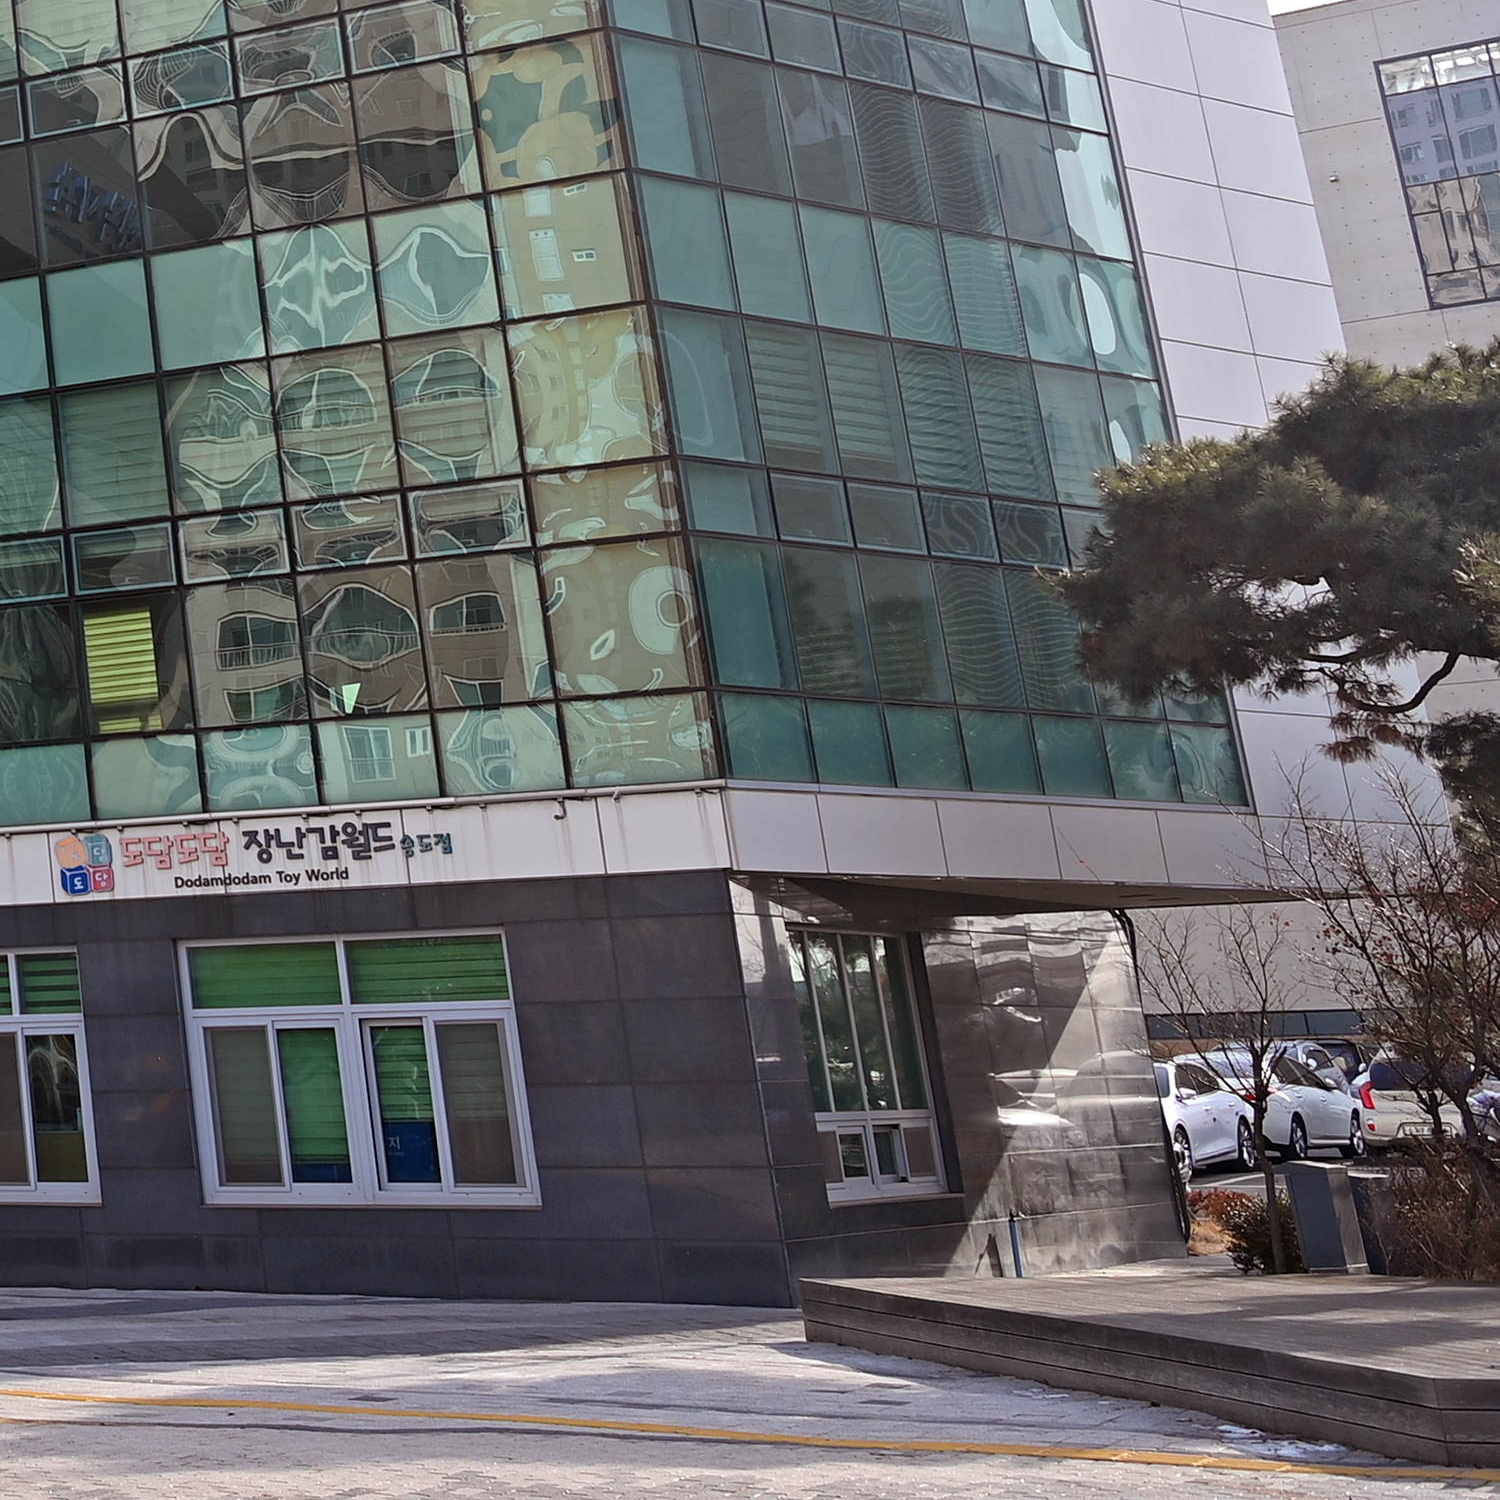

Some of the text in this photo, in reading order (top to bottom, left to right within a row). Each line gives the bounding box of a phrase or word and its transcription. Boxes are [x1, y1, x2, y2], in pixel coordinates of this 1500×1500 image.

[120, 821, 453, 870] 도담도담 장난감월드 송도점
[174, 866, 349, 889] Dodamdodam Toy World
